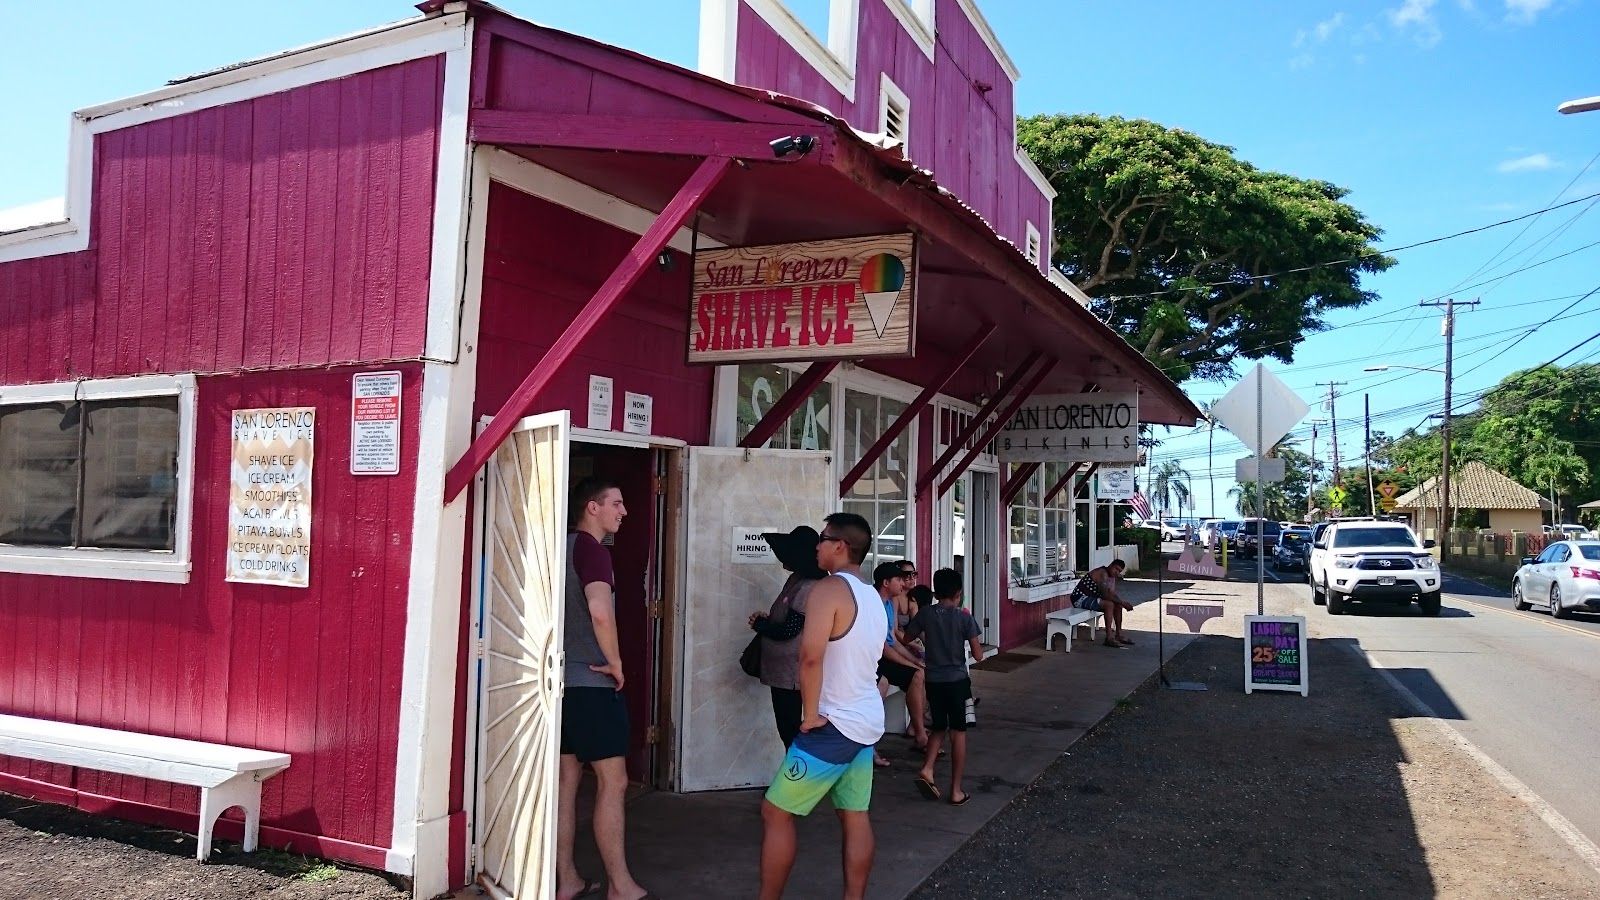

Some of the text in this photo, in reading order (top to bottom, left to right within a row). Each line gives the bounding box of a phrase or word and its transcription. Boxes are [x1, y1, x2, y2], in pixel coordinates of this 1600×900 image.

[704, 260, 744, 289] San
[695, 283, 856, 352] SHAVE ICE
[632, 401, 644, 409] NOW
[234, 411, 313, 430] SAN LORENZO
[1047, 403, 1131, 430] LORENZO
[234, 429, 312, 440] SHAVE ICE
[1005, 436, 1130, 450] BIKINIS
[249, 455, 294, 466] SHAVE ICE
[248, 473, 295, 484] ICE CREAM
[245, 491, 298, 502] SMOOTHIES
[243, 508, 264, 519] ACAI
[238, 525, 303, 539] PITAYA BOWLS
[231, 542, 309, 556] ICE CREAM FLOATS
[240, 560, 298, 573] COLD DRINKS
[1179, 562, 1213, 575] BIKINI
[1178, 605, 1212, 615] POINT
[1253, 623, 1281, 635] LABOR
[1278, 656, 1299, 664] SALE
